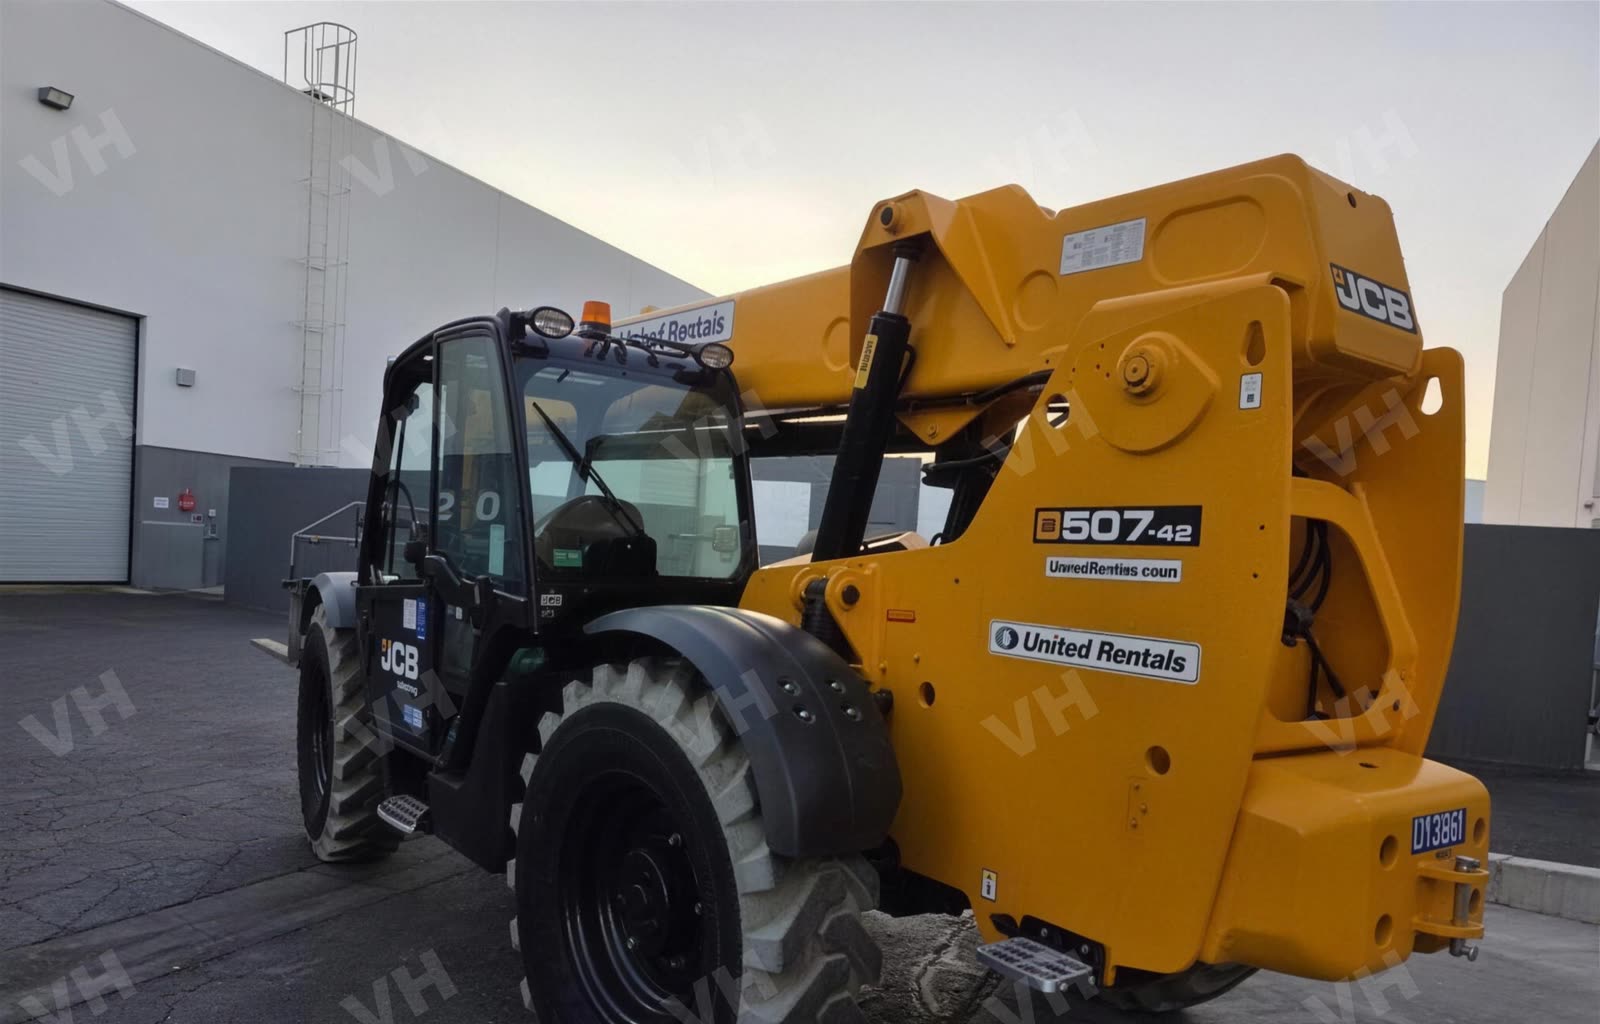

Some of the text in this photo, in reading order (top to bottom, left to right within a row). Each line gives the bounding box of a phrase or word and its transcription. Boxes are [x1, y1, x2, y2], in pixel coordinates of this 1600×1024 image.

[1335, 271, 1414, 330] JCB
[381, 639, 419, 680] JCB
[1023, 631, 1187, 673] United Rentals
